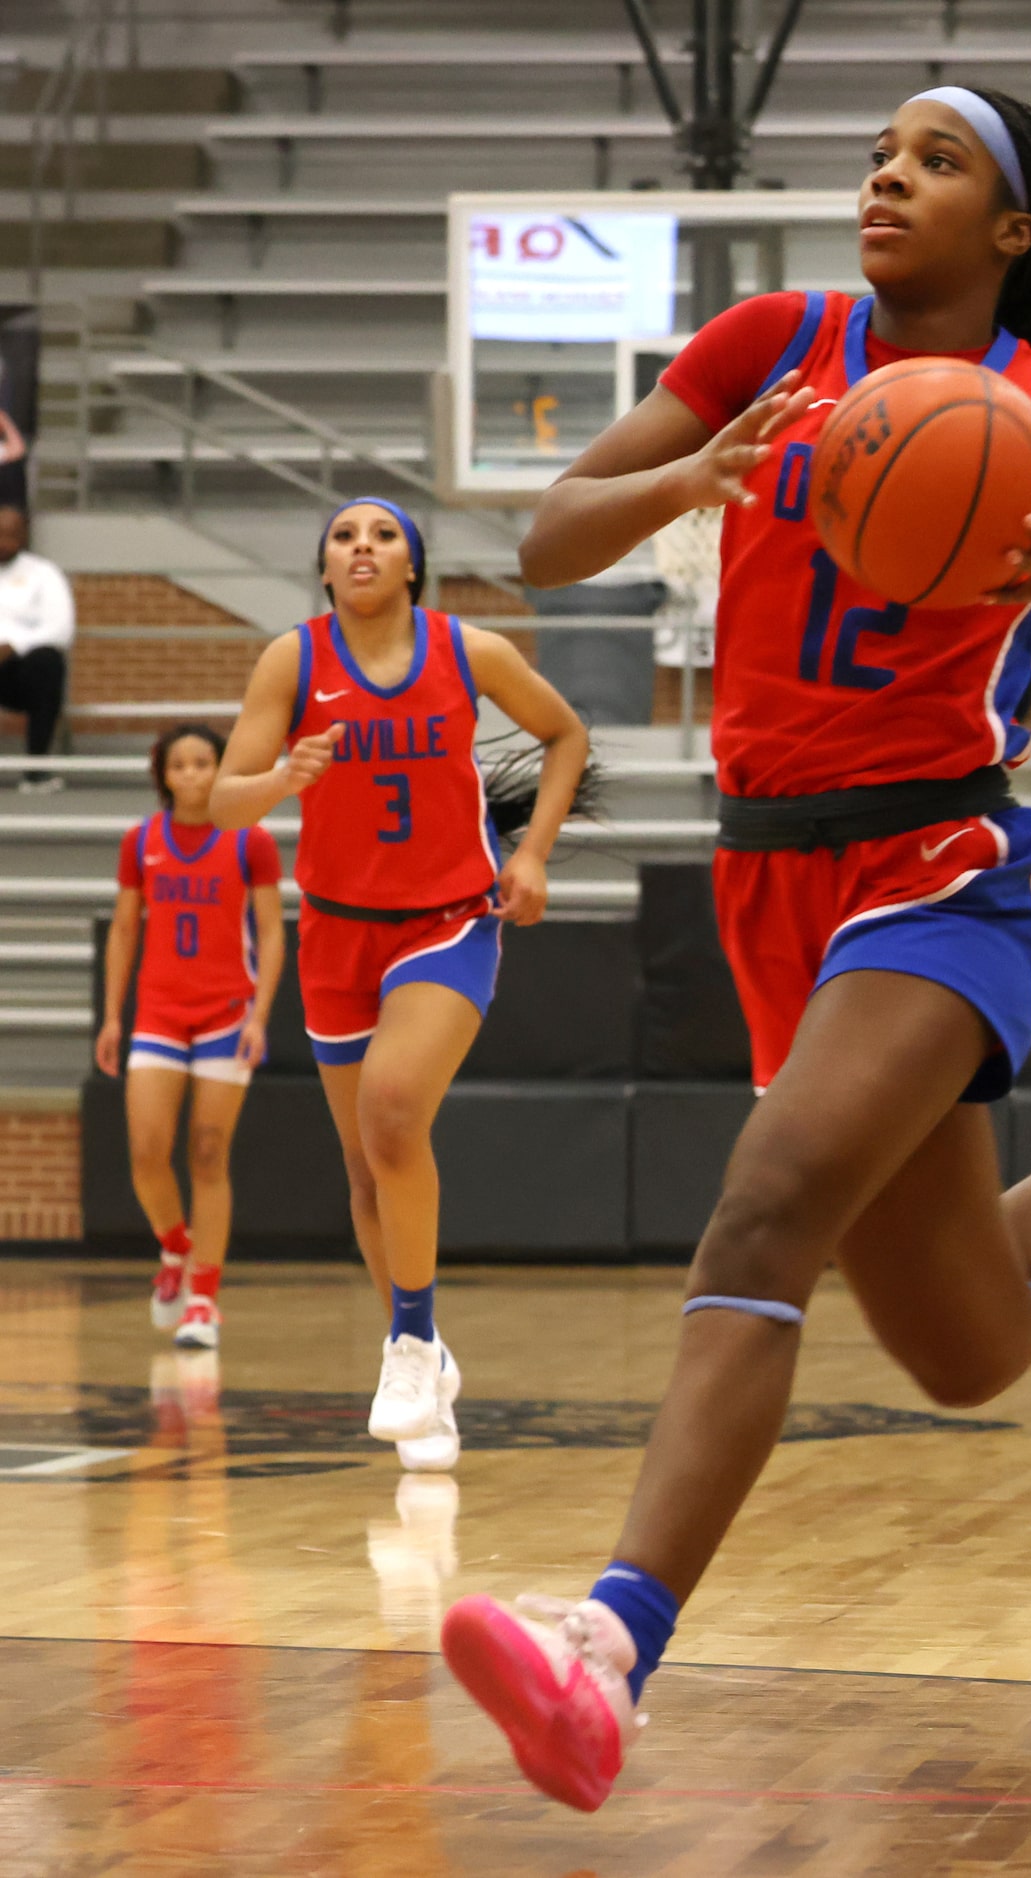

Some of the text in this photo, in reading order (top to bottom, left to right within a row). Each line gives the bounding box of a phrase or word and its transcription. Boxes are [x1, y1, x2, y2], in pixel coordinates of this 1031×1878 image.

[799, 549, 909, 690] 12
[373, 773, 412, 843] 3
[175, 912, 199, 958] 0
